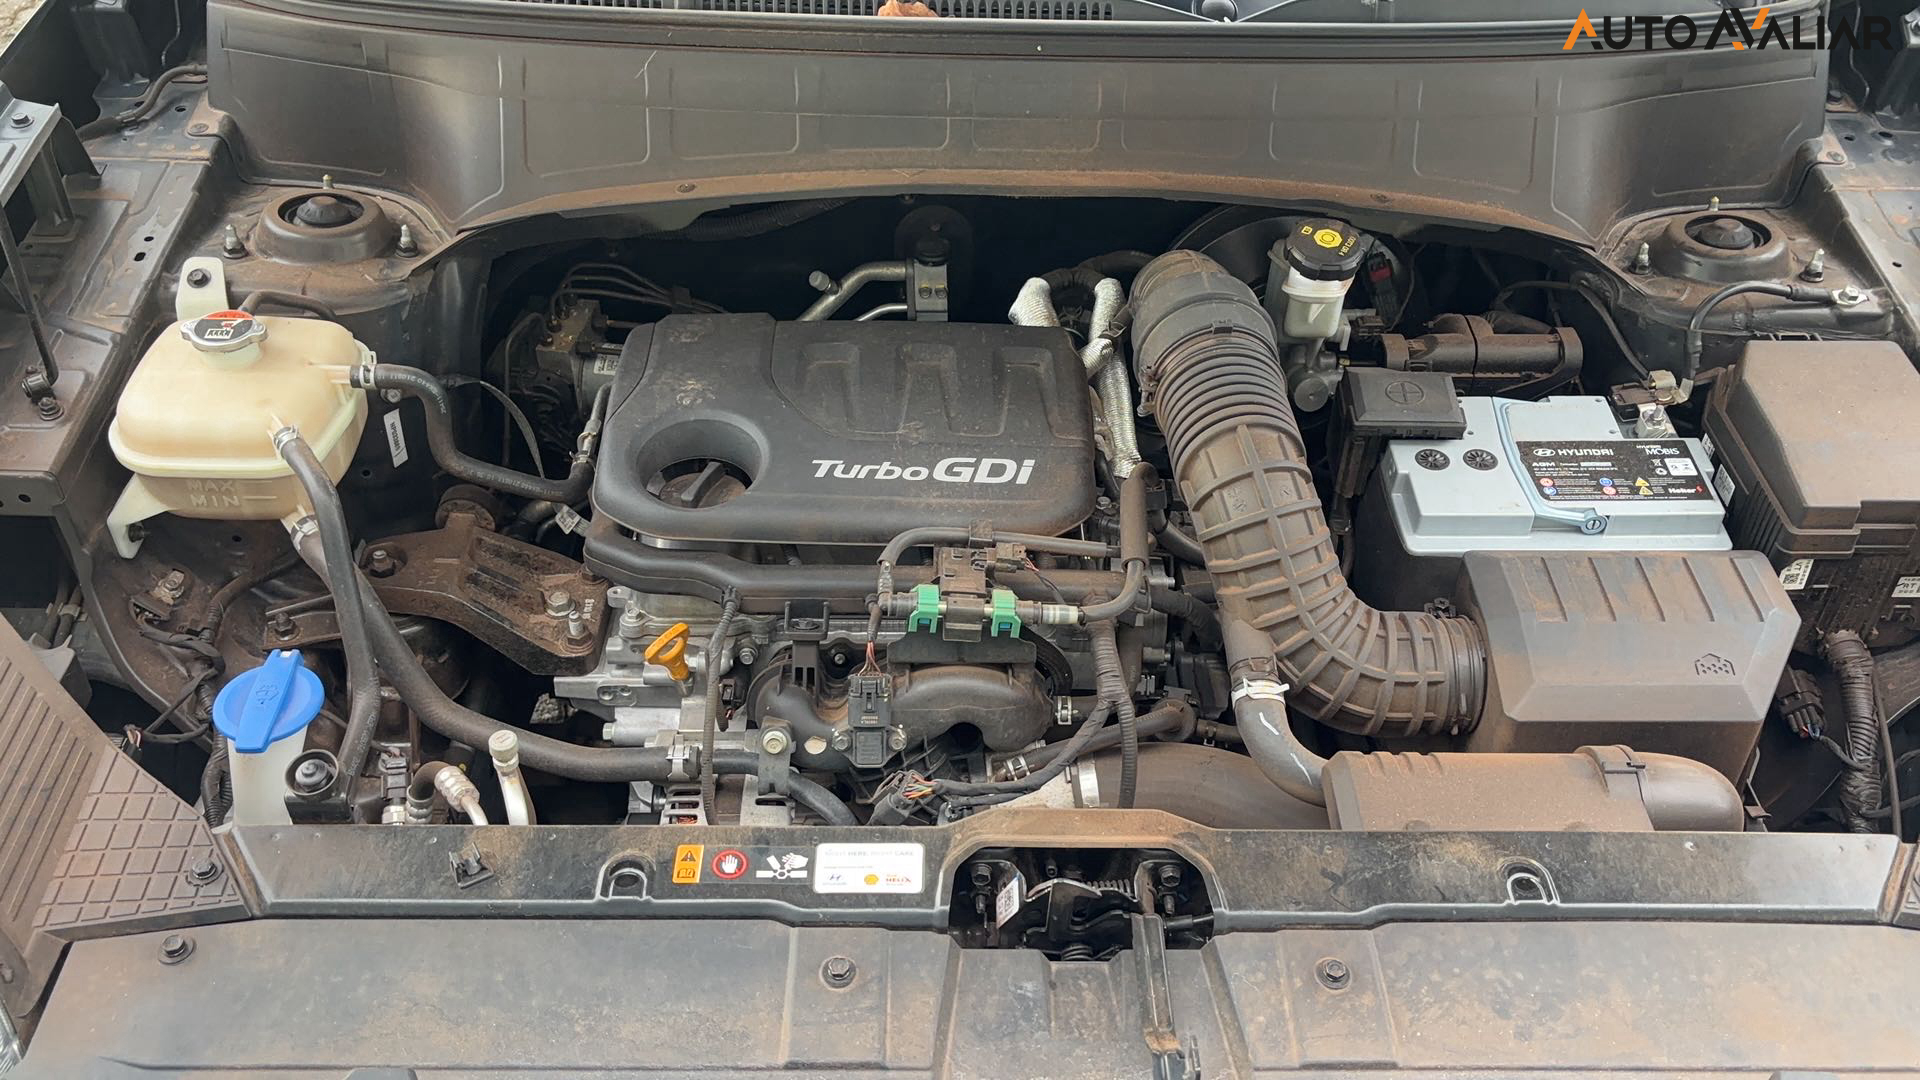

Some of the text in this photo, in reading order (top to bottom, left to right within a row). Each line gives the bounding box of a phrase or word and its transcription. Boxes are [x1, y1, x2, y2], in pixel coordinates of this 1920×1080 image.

[1558, 448, 1614, 456] HYUNDAI
[1646, 447, 1680, 455] MOBIS
[186, 480, 235, 492] MAX
[190, 494, 240, 507] MIN
